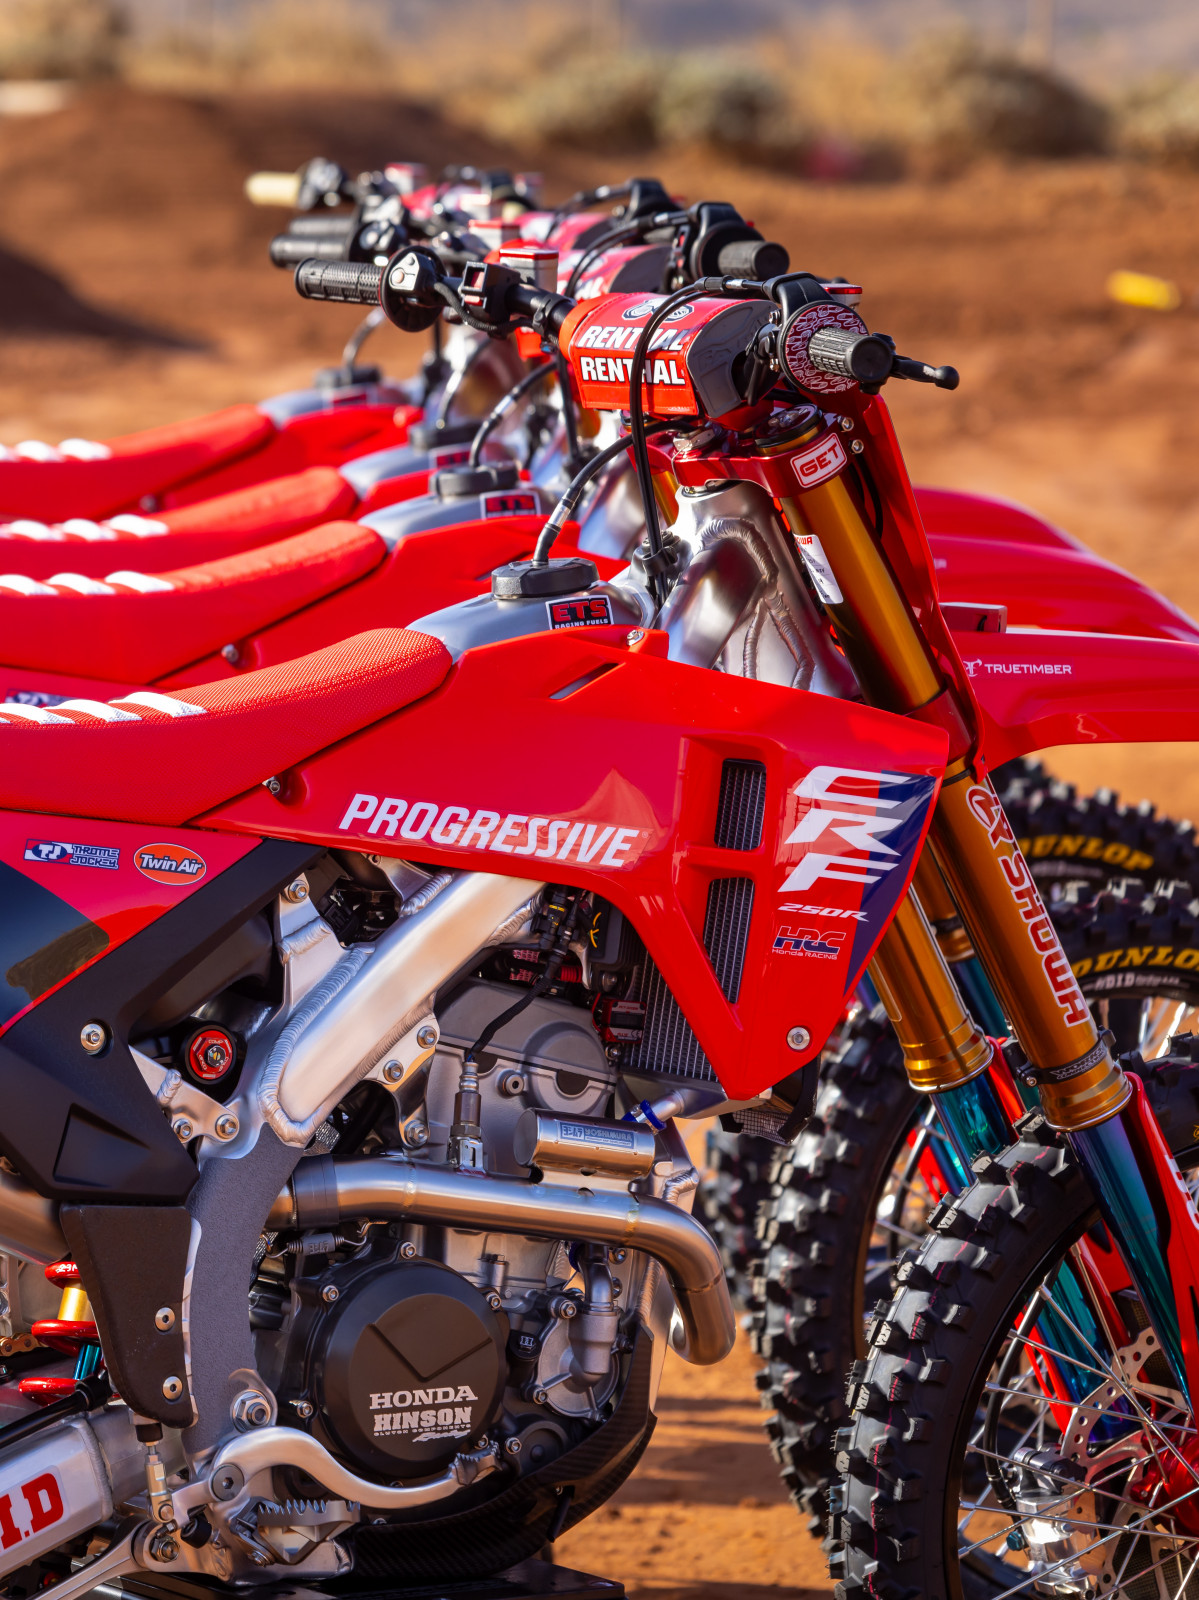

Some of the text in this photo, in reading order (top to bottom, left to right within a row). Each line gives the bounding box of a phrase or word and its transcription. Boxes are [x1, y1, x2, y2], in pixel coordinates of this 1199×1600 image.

[799, 442, 839, 477] GET
[552, 600, 607, 622] ETS
[586, 618, 609, 626] FUELS
[984, 663, 1073, 675] TRUETIMBER
[338, 793, 640, 868] PROGRESSIVE
[777, 765, 912, 893] CRF
[73, 844, 120, 858] THROTTLE
[140, 853, 202, 875] Twin Air
[777, 902, 870, 923] 250R
[772, 925, 847, 955] HRC
[998, 850, 1091, 1028] SHOWA
[771, 948, 838, 960] Honda RACING
[1070, 945, 1199, 979] DUNLO
[584, 1127, 633, 1142] YOSHIMURA
[369, 1385, 479, 1410] HONDA
[373, 1406, 472, 1432] HINSON
